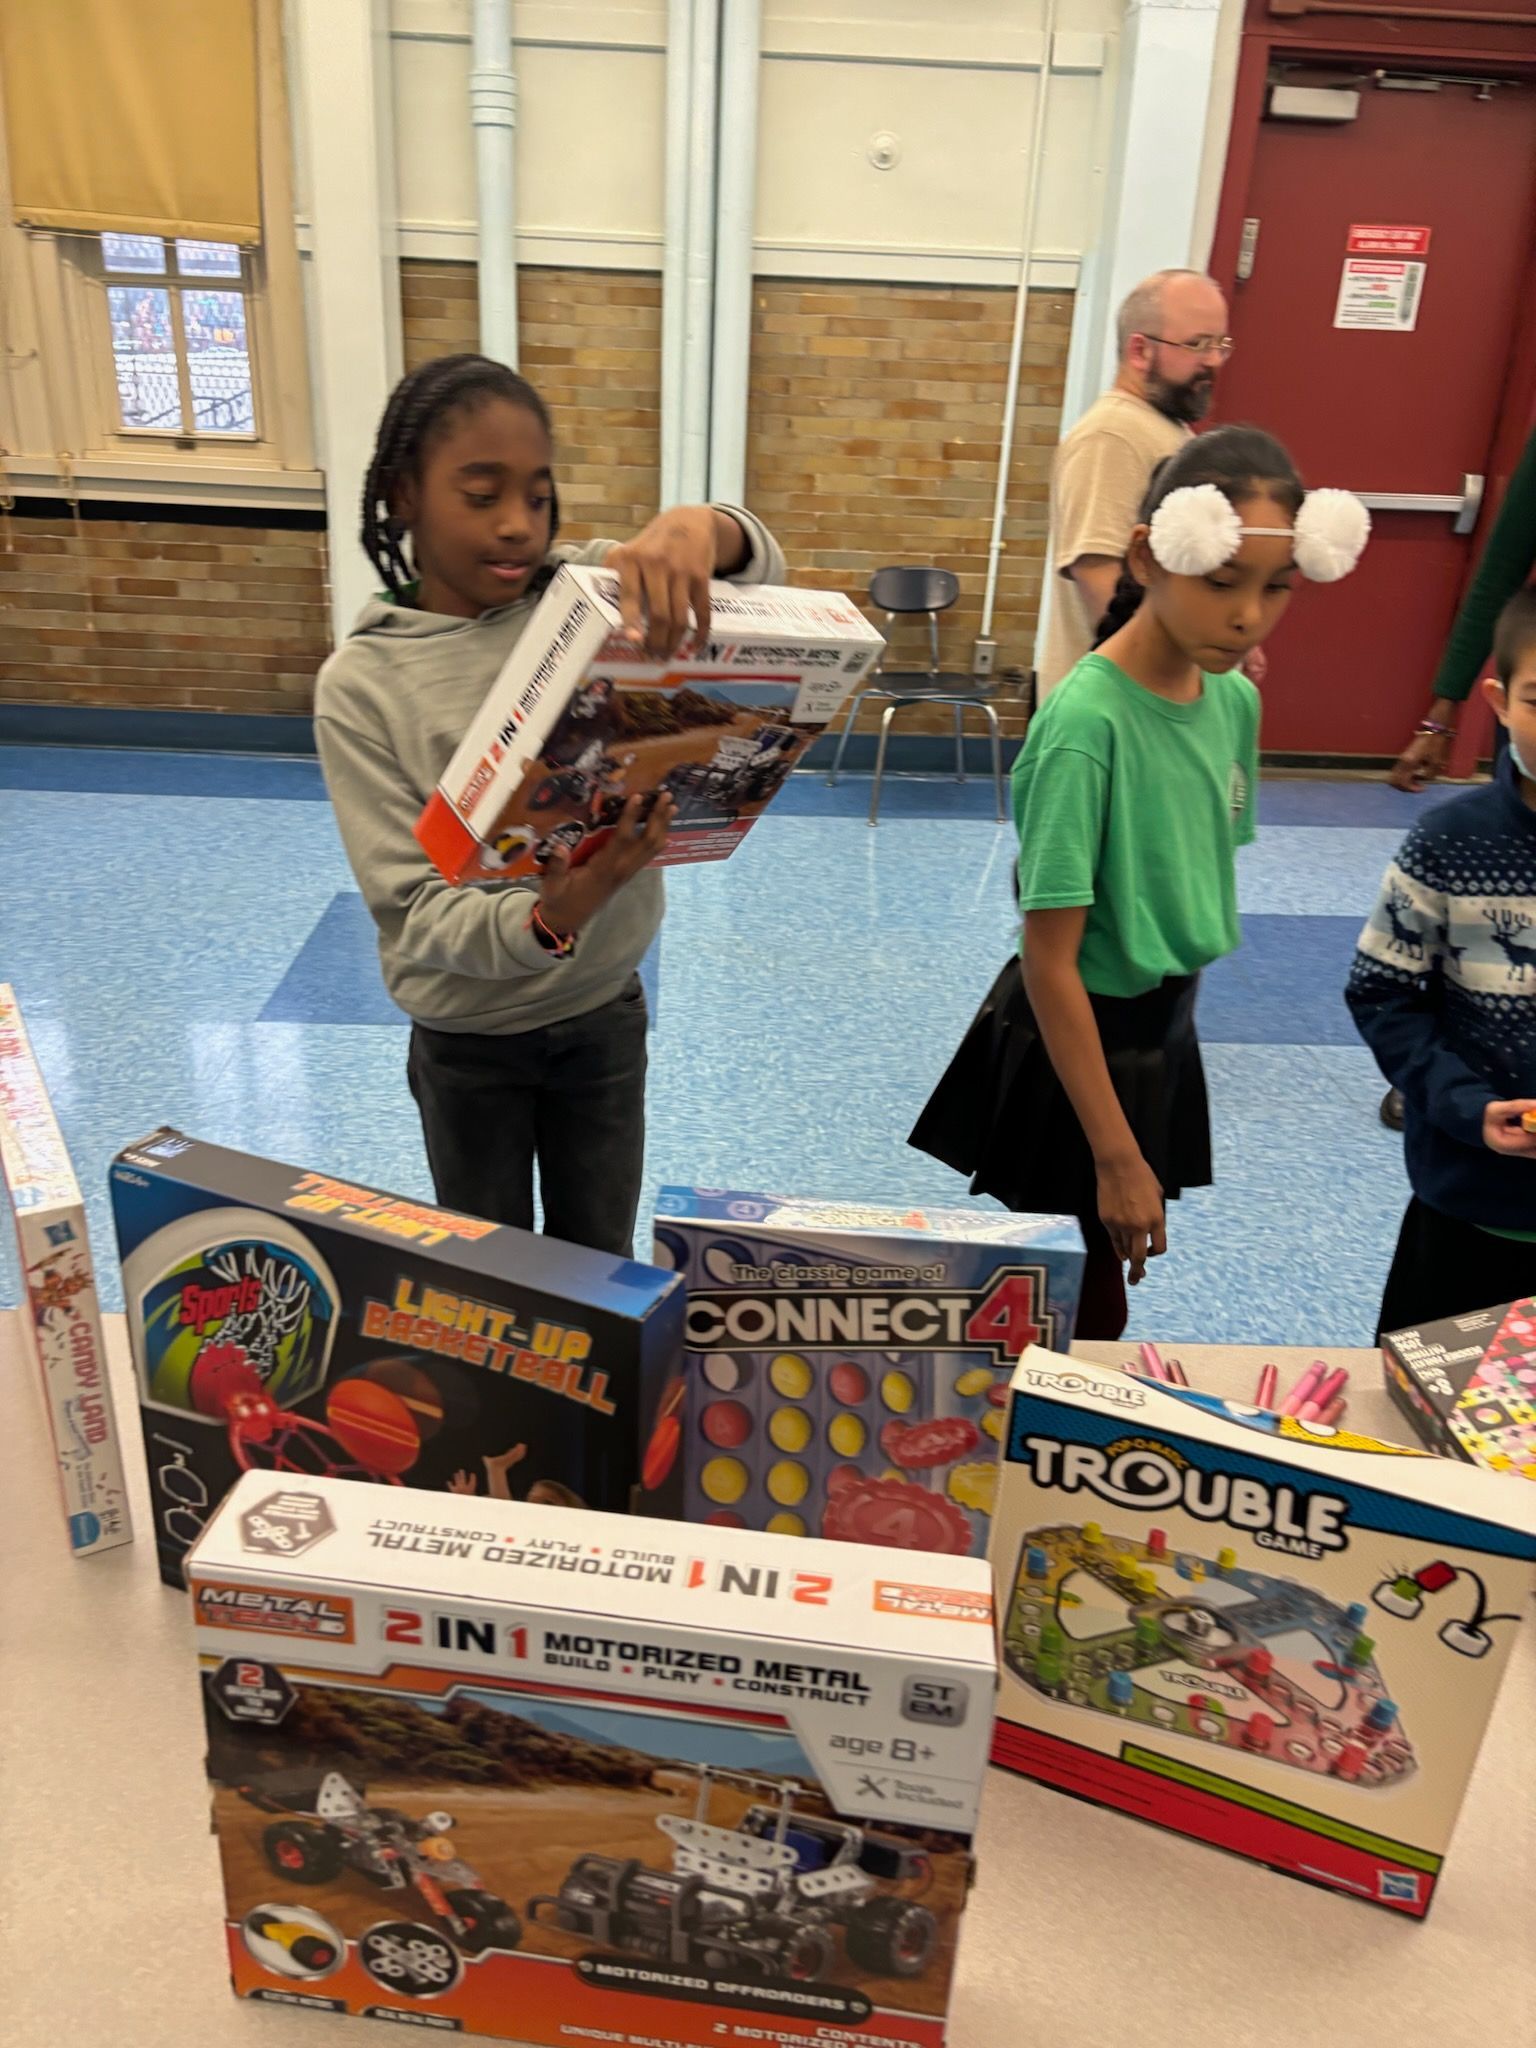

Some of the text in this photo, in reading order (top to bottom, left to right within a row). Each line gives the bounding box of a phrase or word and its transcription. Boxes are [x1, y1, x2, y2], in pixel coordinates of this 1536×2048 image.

[731, 1263, 946, 1285] The classic game of
[179, 1275, 263, 1336] Sports
[394, 1277, 592, 1361] LIGHT-UP
[686, 1274, 1040, 1355] CONNECT 4
[70, 1320, 100, 1391] CANDY
[362, 1301, 616, 1414] BASKETBALL
[1026, 1369, 1146, 1406] TROUBLE
[78, 1388, 106, 1445] LAND
[1025, 1437, 1348, 1548] TROUBLE
[372, 1518, 676, 1565] BUILD PLAY CONSTRUCT
[1256, 1531, 1324, 1559] GAME
[366, 1530, 833, 1605] 2 IN 1 MOTORIZED METAL
[200, 1587, 346, 1619] METAL
[385, 1609, 871, 1692] 2 IN 1 MOTORIZED METAL
[236, 1663, 264, 1688] 2
[543, 1652, 870, 1706] BUILD PLAY CONSTRUCT
[912, 1682, 957, 1701] ST
[908, 1701, 955, 1718] EM
[829, 1733, 936, 1762] age 8+
[596, 1963, 846, 2011] MOTORIZED OFFROADERS
[559, 2023, 625, 2042] UNIQUE
[713, 2022, 728, 2034] 2
[733, 2024, 849, 2048] MOTORIZED
